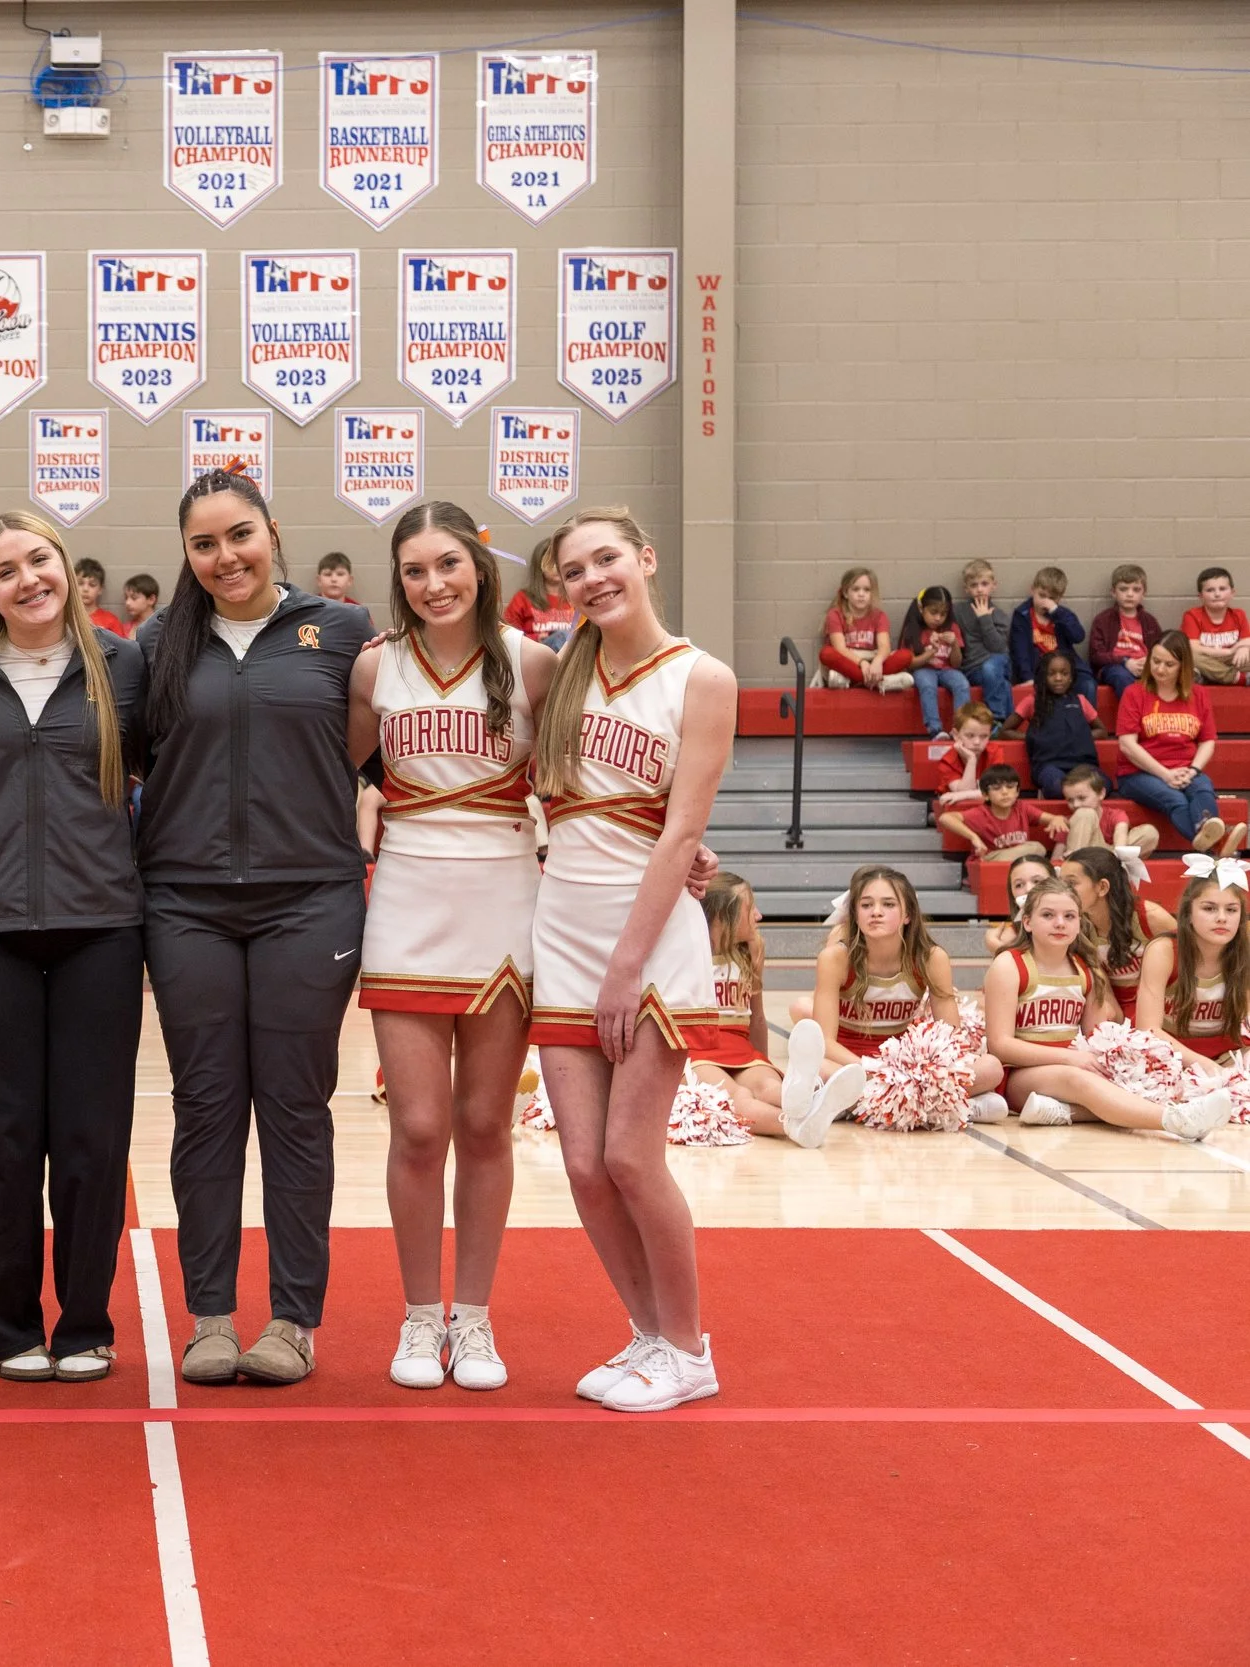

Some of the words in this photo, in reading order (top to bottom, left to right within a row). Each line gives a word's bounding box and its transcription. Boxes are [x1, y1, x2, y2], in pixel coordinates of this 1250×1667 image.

[174, 126, 273, 146] VOLLEYBALL
[329, 126, 429, 146] BASKETBALL
[487, 125, 521, 142] GIRLS
[523, 124, 586, 141] ATHLETICS
[174, 146, 273, 168] CHAMPION
[329, 147, 429, 168] RUNNERUP
[487, 142, 586, 162] CHAMPION
[198, 172, 247, 190] 2021
[353, 173, 403, 190] 2021
[511, 171, 560, 187] 2021
[214, 195, 234, 208] 1A
[370, 196, 390, 209] 1A
[527, 194, 547, 207] 1A
[98, 322, 196, 342] TENNIS
[252, 322, 350, 342] VOLLEYBALL
[408, 322, 506, 341] VOLLEYBALL
[589, 321, 646, 341] GOLF
[98, 342, 196, 364] CHAMPION
[252, 343, 350, 364] CHAMPION
[408, 342, 506, 363] CHAMPION
[568, 342, 666, 363] CHAMPION
[696, 275, 722, 437] WARRIORS
[122, 369, 172, 386] 2023
[276, 369, 326, 386] 2023
[431, 368, 482, 385] 2024
[591, 368, 642, 386] 2025
[138, 391, 158, 404] 1A
[293, 391, 312, 404] 1A
[448, 391, 467, 403] 1A
[608, 391, 627, 404] 1A
[37, 453, 100, 465] DISTRICT
[344, 451, 414, 463] DISTRICT
[499, 451, 569, 464] DISTRICT
[37, 467, 100, 479] TENNIS
[344, 465, 414, 477] TENNIS
[499, 464, 569, 477] TENNIS
[37, 481, 100, 494] CHAMPION
[344, 479, 414, 492] CHAMPION
[499, 478, 569, 492] RUNNER-UP
